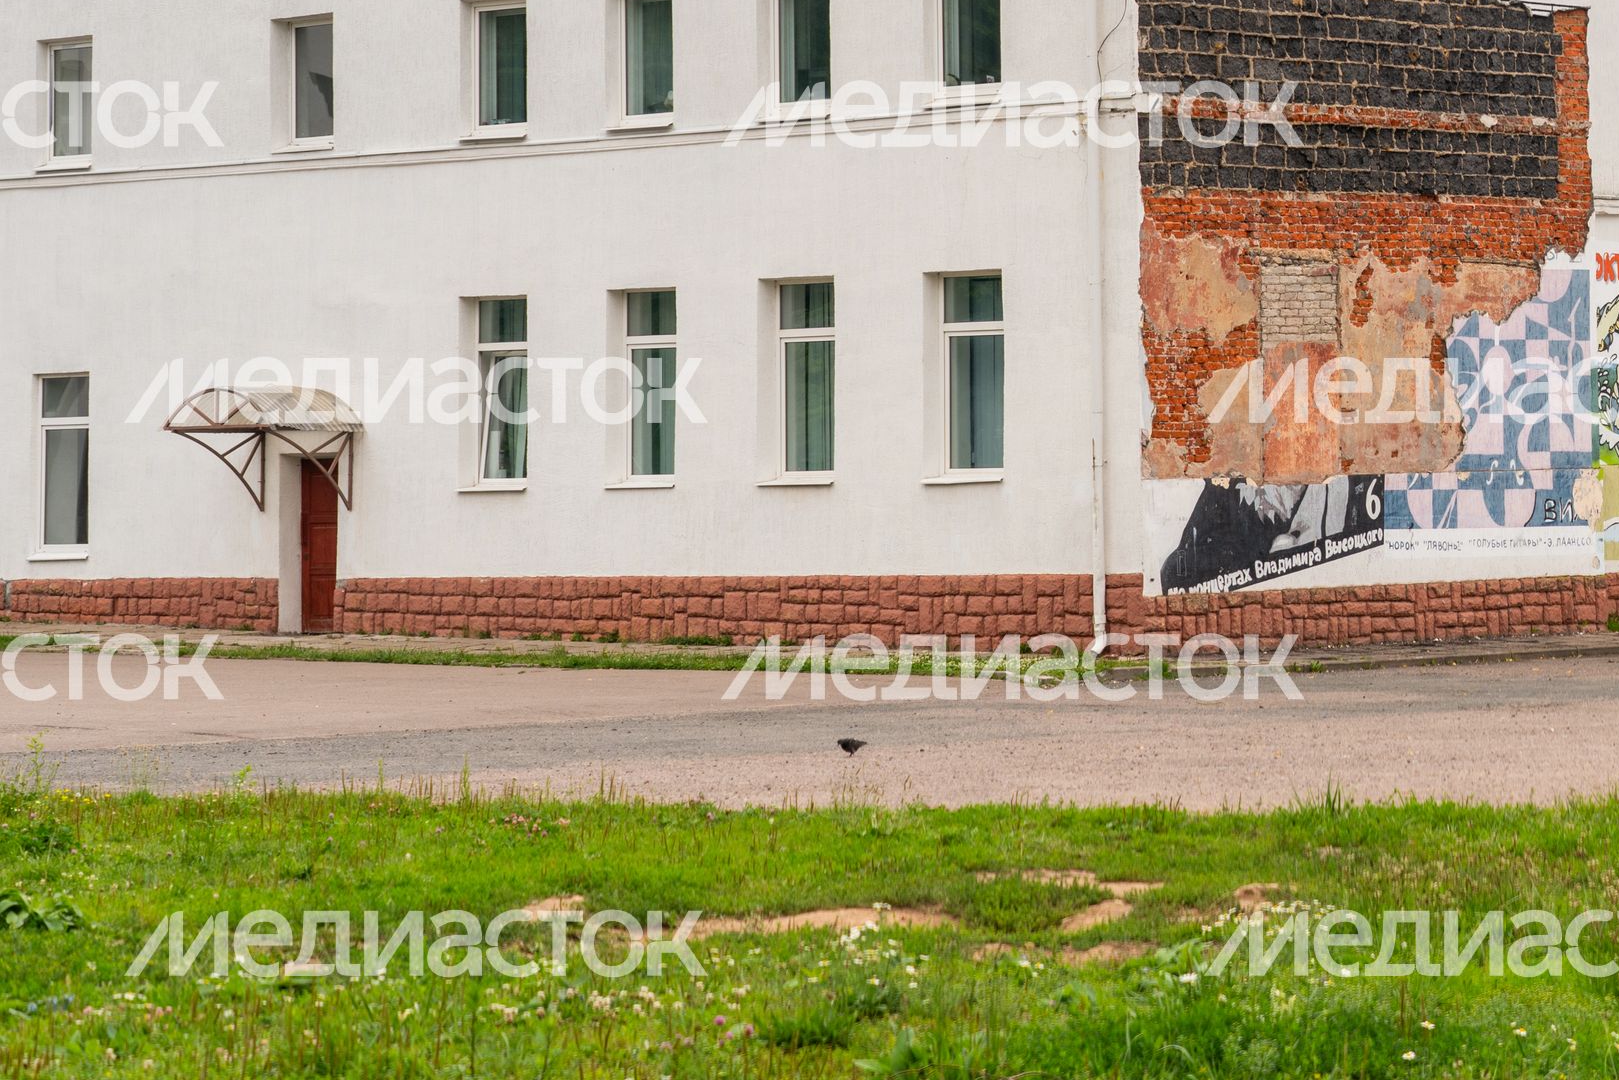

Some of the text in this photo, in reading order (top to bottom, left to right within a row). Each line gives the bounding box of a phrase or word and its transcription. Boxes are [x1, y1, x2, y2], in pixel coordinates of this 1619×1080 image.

[1366, 478, 1382, 520] 6
[1544, 497, 1577, 523] ВИ
[1254, 546, 1322, 580] Владимира
[1325, 528, 1383, 560] Высоцкого
